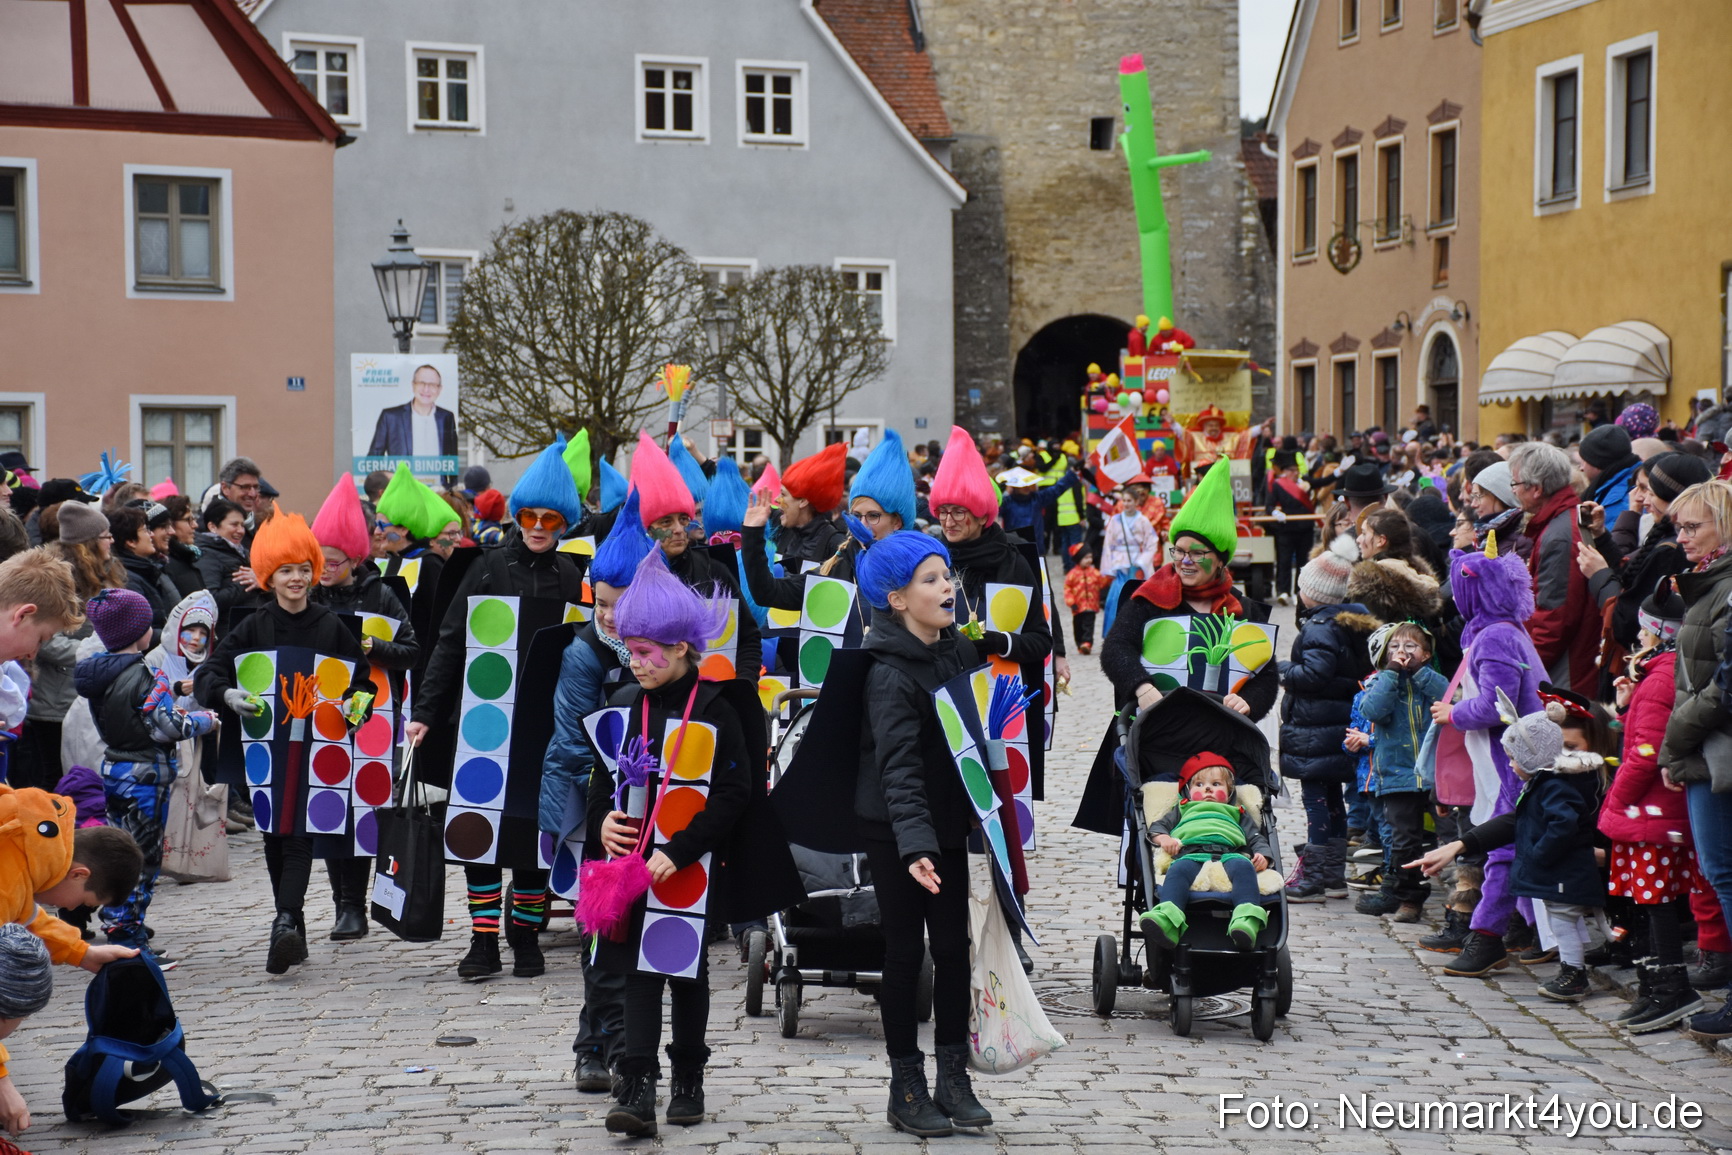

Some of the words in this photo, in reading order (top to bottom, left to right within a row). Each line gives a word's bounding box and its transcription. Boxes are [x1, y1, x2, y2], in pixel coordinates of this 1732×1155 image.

[362, 375, 400, 384] WÄHLER
[1148, 368, 1177, 381] LEGO
[291, 377, 301, 386] 11
[414, 459, 455, 472] BINDER
